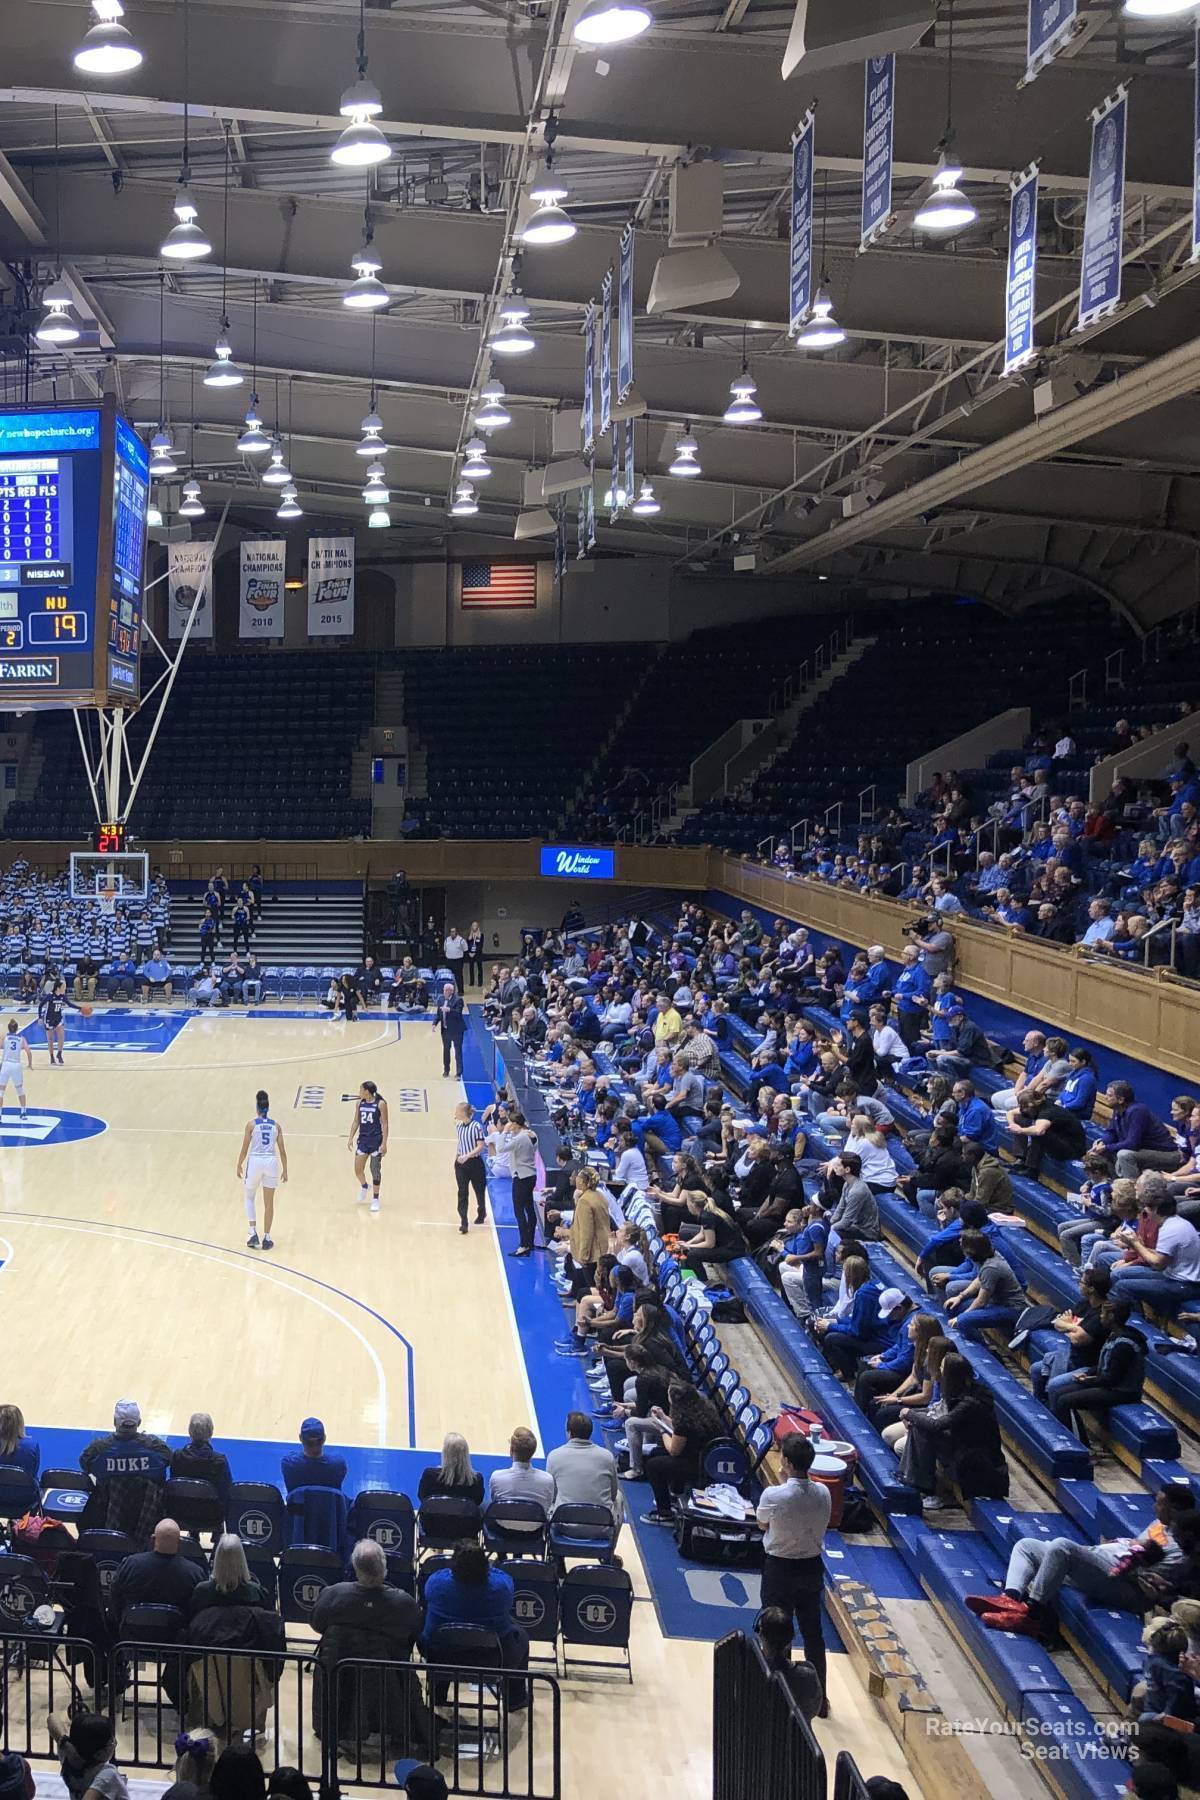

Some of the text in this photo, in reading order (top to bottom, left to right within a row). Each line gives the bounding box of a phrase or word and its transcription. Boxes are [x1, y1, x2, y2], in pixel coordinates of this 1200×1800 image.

[17, 487, 36, 496] REB
[39, 486, 56, 496] FLS
[4, 500, 9, 510] 2
[24, 499, 30, 509] 4
[3, 512, 10, 522] 0
[45, 511, 51, 520] 2
[24, 524, 31, 533] 4
[45, 523, 52, 533] 0
[4, 537, 10, 547] 3
[24, 536, 31, 546] 0
[45, 535, 52, 545] 0
[4, 549, 10, 559] 0
[45, 548, 52, 558] 0
[246, 553, 279, 561] NATIONAL
[315, 550, 348, 558] NATINAL
[242, 563, 283, 573] CHAMPIONS
[311, 560, 352, 570] CHMPIONS
[27, 570, 64, 579] NISSAN
[46, 597, 67, 610] NU
[251, 618, 273, 626] 2010
[320, 615, 342, 624] 2015
[55, 616, 76, 638] 19
[6, 631, 16, 645] 2
[101, 826, 123, 835] 4:31
[99, 836, 119, 852] 27
[557, 851, 600, 873] Window
[11, 1041, 17, 1051] 3
[360, 1111, 374, 1124] 24
[262, 1132, 270, 1146] 5
[107, 1456, 150, 1472] DUKE
